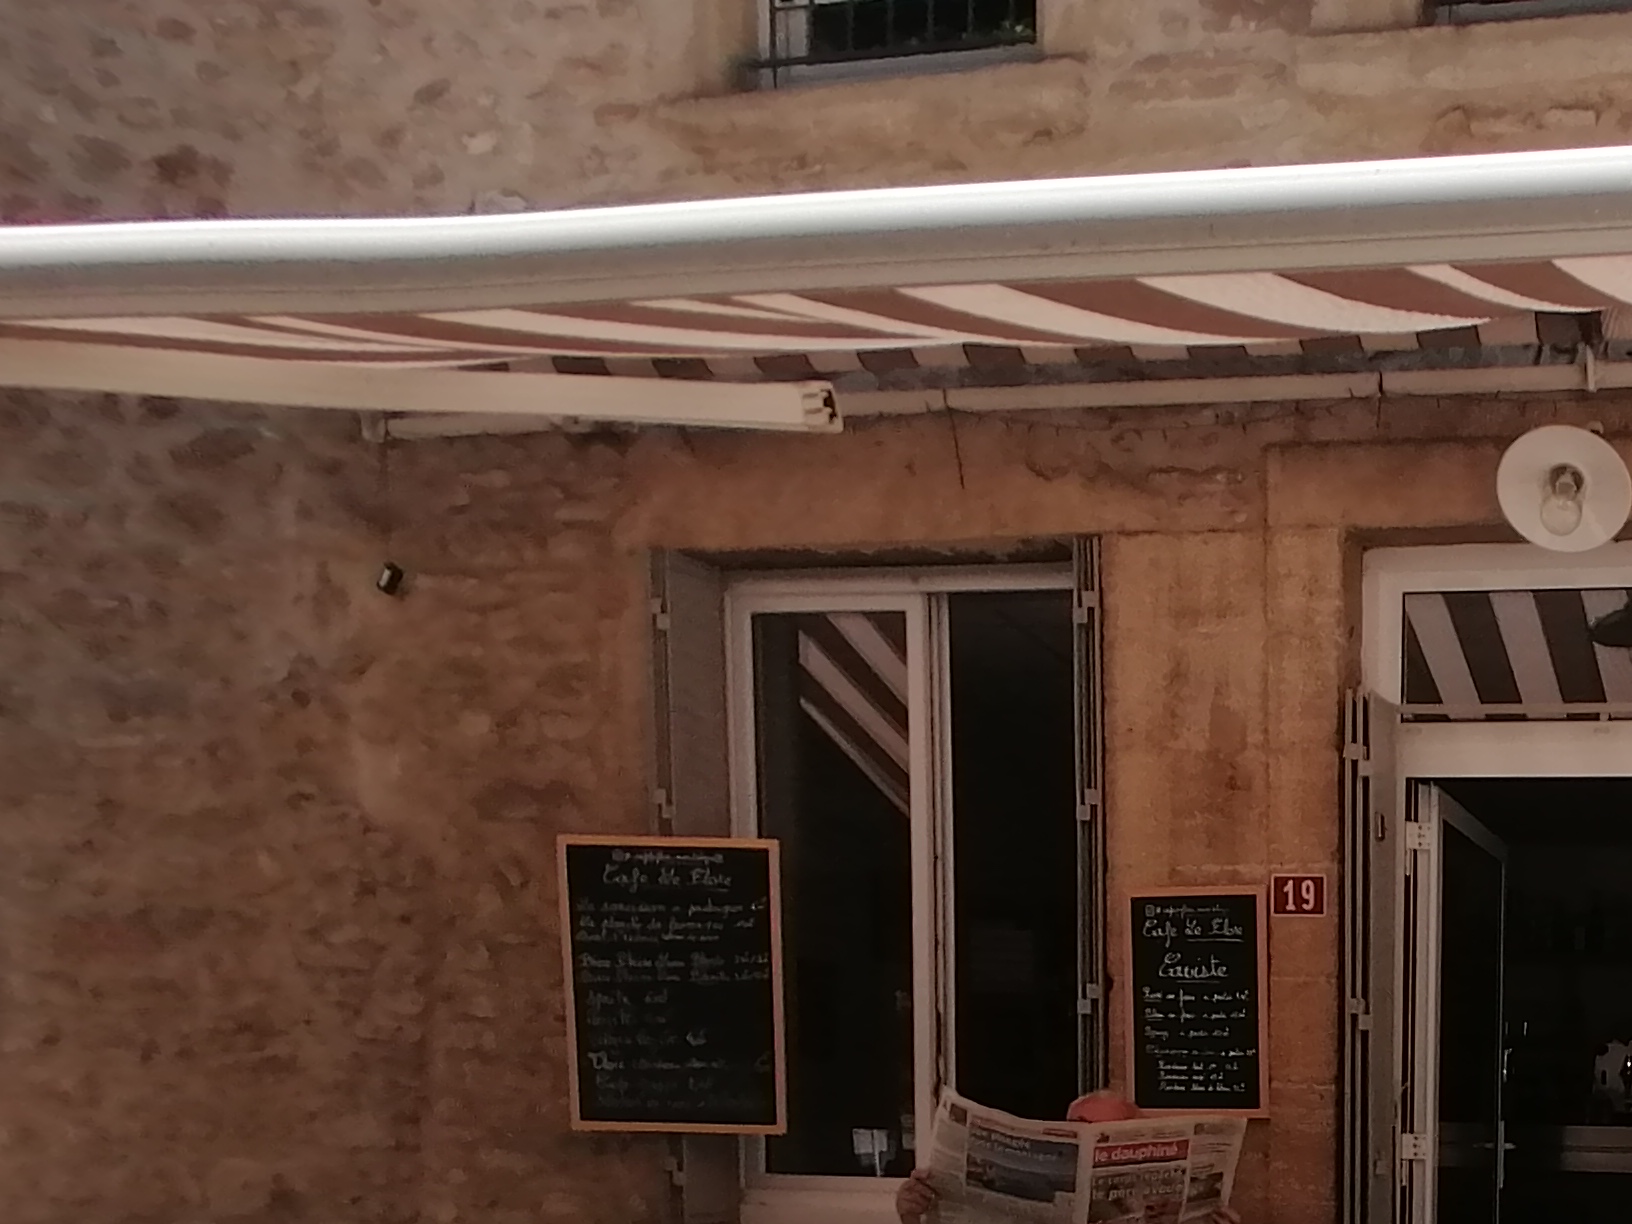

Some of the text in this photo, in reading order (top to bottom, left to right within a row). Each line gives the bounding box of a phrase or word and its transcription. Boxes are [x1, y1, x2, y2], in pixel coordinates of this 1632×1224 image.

[1282, 879, 1316, 911] 19
[1158, 952, 1229, 979] Caviste
[1094, 1142, 1178, 1162] le dauphiné
